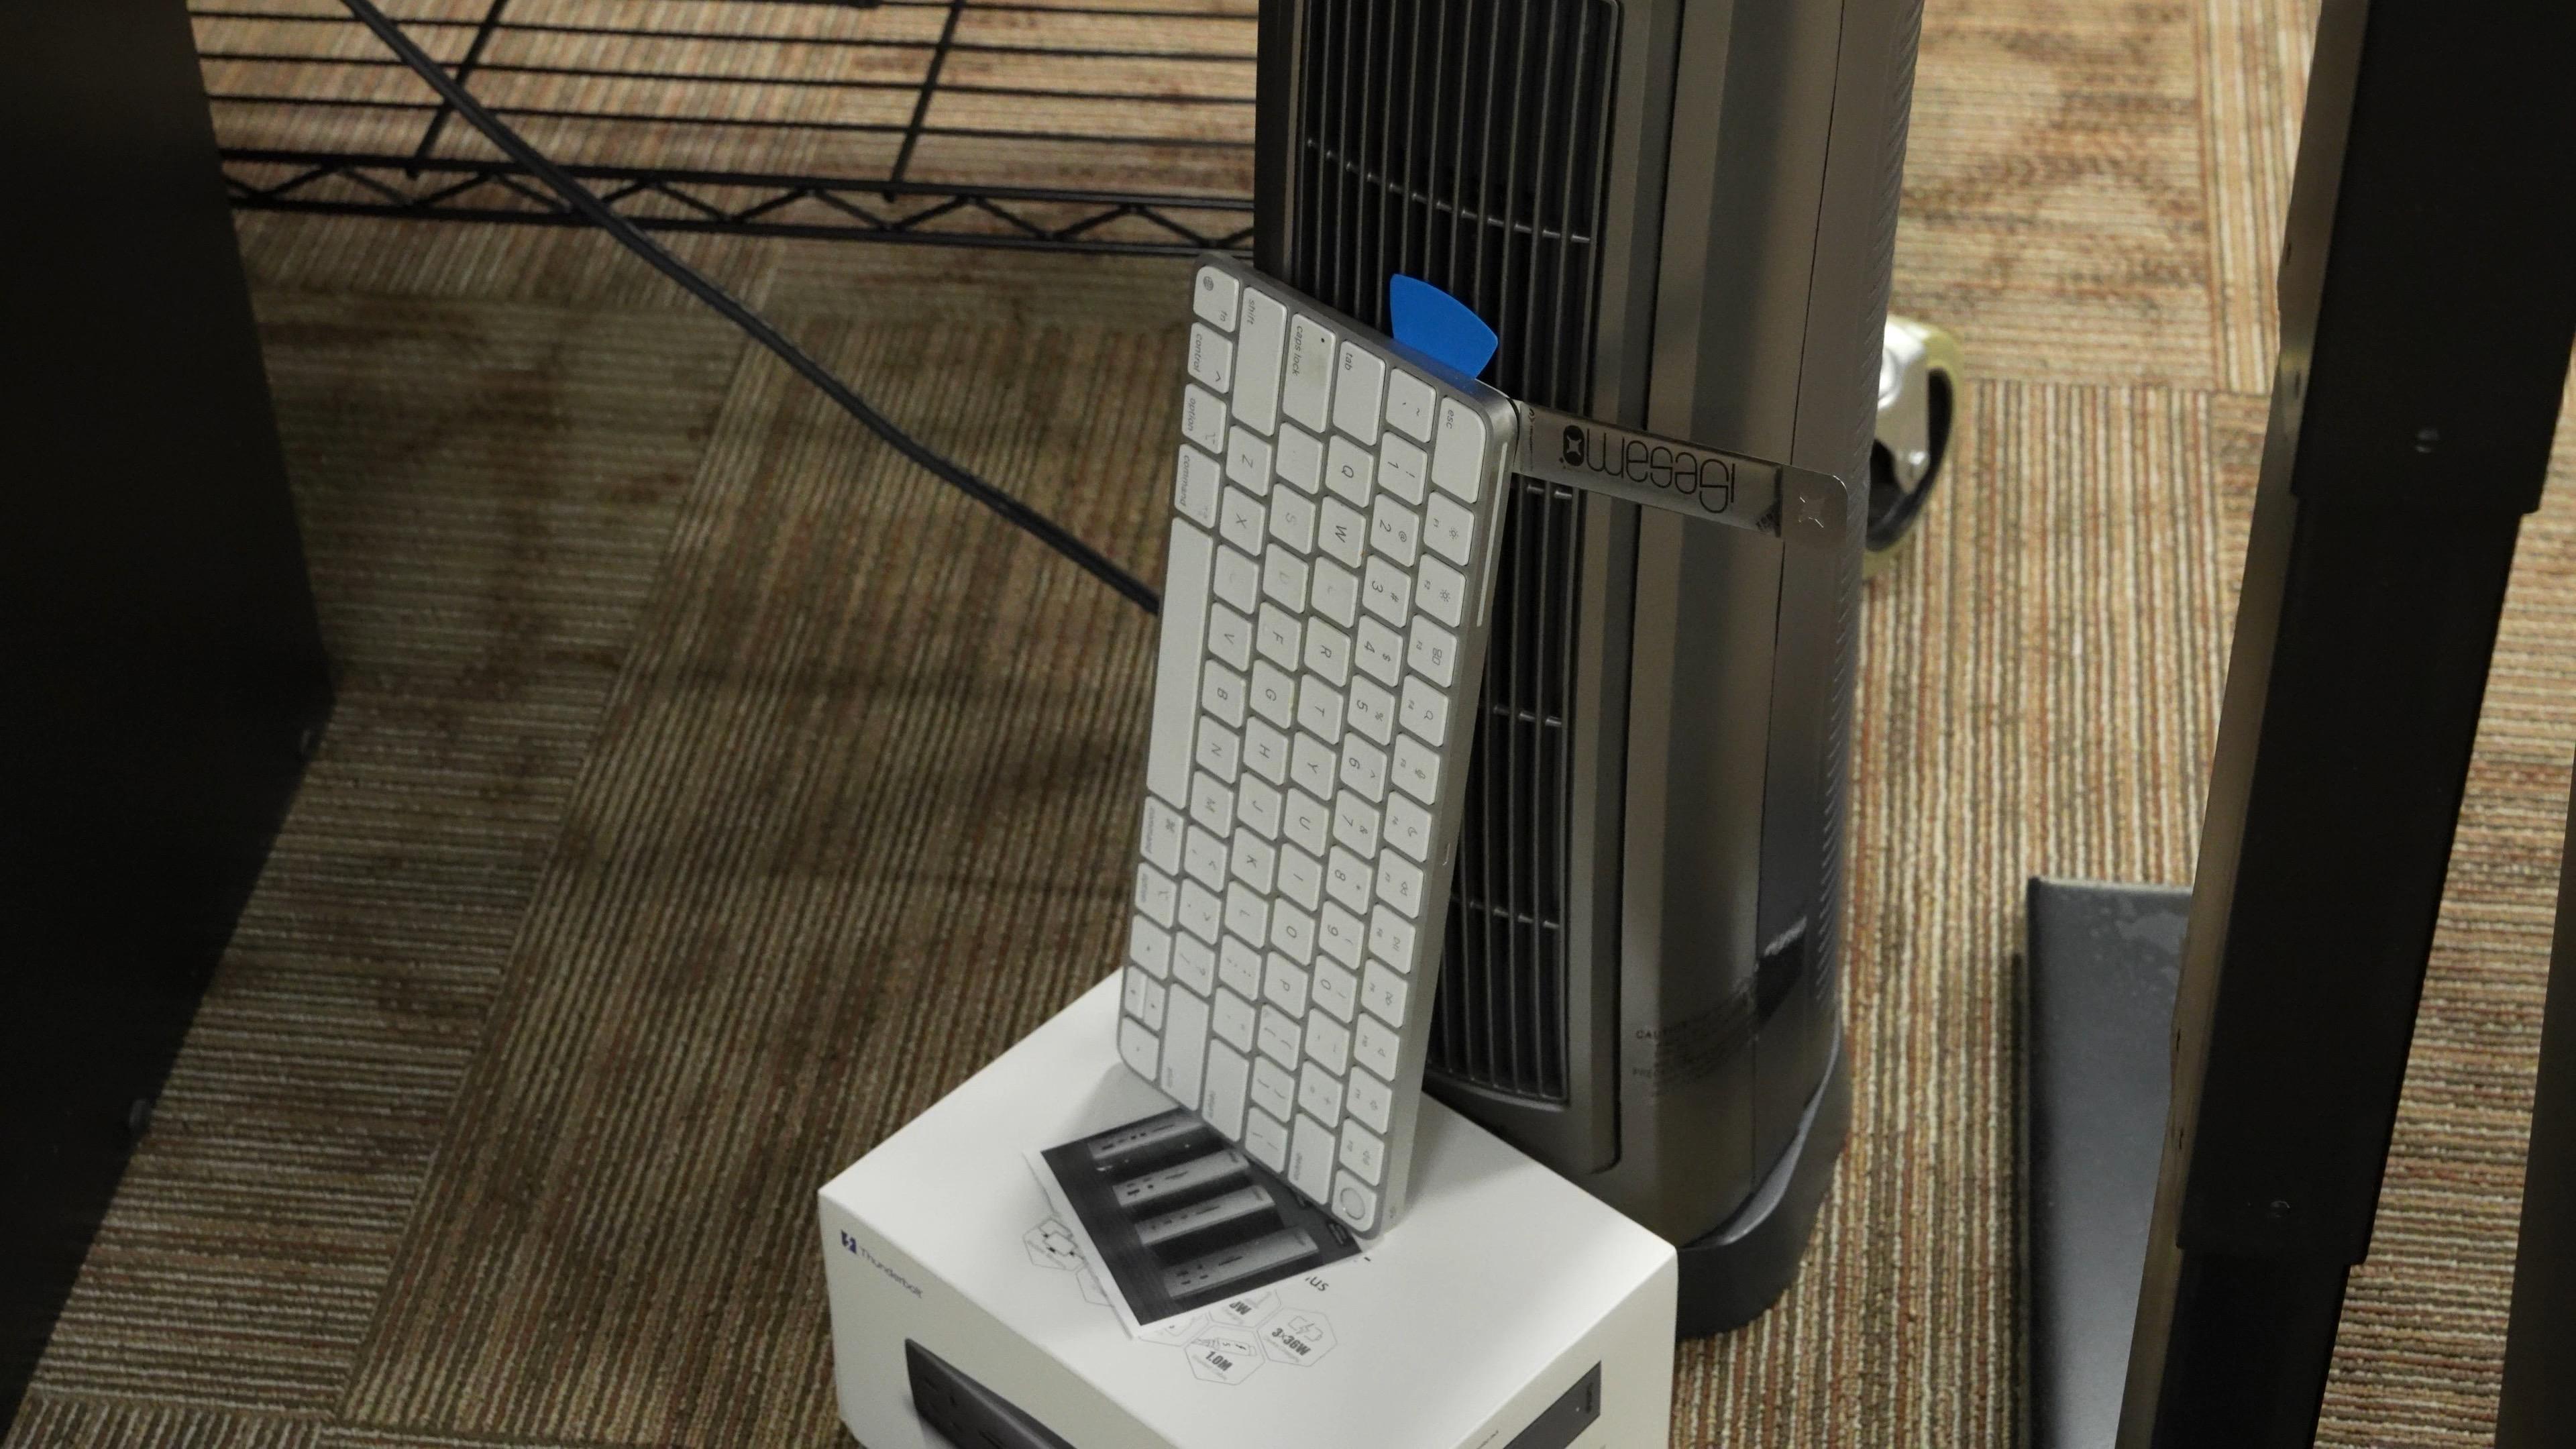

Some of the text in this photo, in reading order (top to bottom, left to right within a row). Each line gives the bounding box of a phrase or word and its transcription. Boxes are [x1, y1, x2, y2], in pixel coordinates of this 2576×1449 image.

[1246, 299, 1256, 325] shift
[1193, 333, 1203, 373] control
[1292, 325, 1303, 376] caps lock
[1344, 352, 1354, 371] tab
[1187, 397, 1197, 432] option
[1446, 409, 1454, 429] esc
[1241, 453, 1254, 469] Z
[1387, 461, 1399, 470] 1
[1341, 465, 1354, 479] Q
[1405, 470, 1415, 478] !
[1180, 454, 1191, 507] command
[1235, 513, 1248, 529] X
[1379, 519, 1392, 533] 2
[1433, 518, 1440, 528] F1
[1334, 525, 1348, 543] W
[1398, 530, 1407, 543] @
[1371, 580, 1384, 594] 3
[1424, 580, 1432, 590] F2
[1390, 592, 1399, 603] #
[1224, 633, 1235, 645] V
[1273, 631, 1284, 645] F
[1320, 645, 1332, 659] R
[1364, 640, 1375, 653] 4
[1415, 640, 1423, 651] F3
[1382, 653, 1391, 662] $
[1217, 687, 1228, 701] B
[1265, 688, 1277, 702] G
[1314, 706, 1326, 717] T
[1356, 699, 1368, 712] 5
[1211, 743, 1222, 757] N
[1259, 743, 1271, 759] H
[1307, 762, 1319, 774] Y
[1348, 757, 1360, 770] 6
[1205, 798, 1216, 813] M
[1251, 800, 1264, 814] J
[1299, 816, 1311, 831] U
[1342, 814, 1354, 827] 7
[1245, 854, 1258, 868] K
[1334, 869, 1346, 882] 8
[1239, 909, 1250, 921] L
[1327, 924, 1339, 937] 9
[1279, 979, 1291, 992] P
[1320, 978, 1332, 991] 0
[1205, 1350, 1233, 1371] 1.0M
